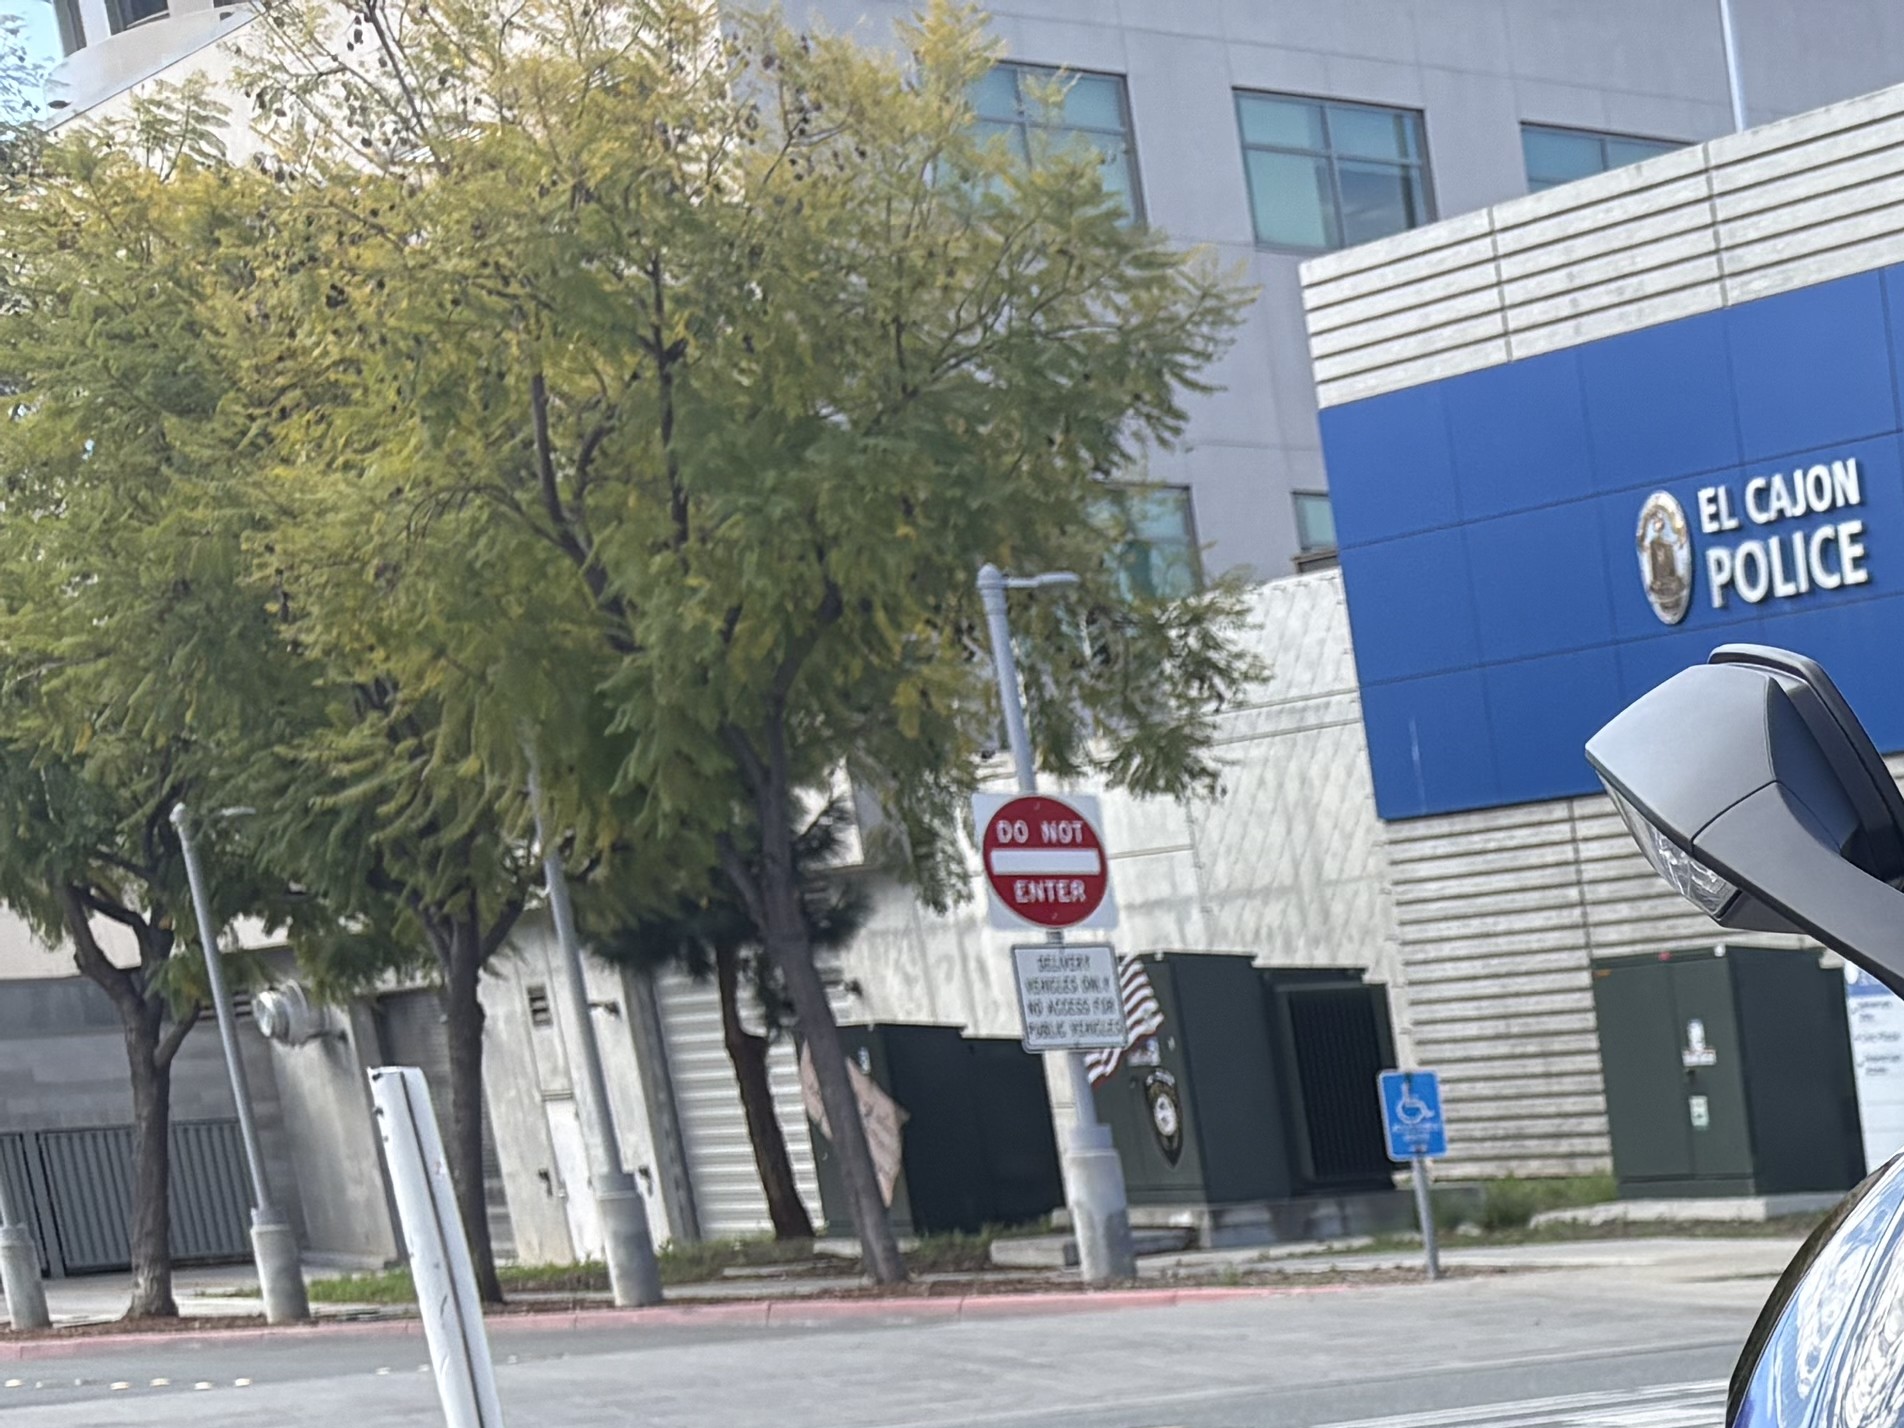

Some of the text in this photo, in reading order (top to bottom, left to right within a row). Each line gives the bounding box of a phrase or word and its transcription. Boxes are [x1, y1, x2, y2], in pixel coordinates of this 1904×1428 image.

[1697, 457, 1862, 534] EL CAJON
[1705, 519, 1869, 608] POLICE
[996, 819, 1083, 844] DO NOT
[1014, 879, 1086, 904] ENTER
